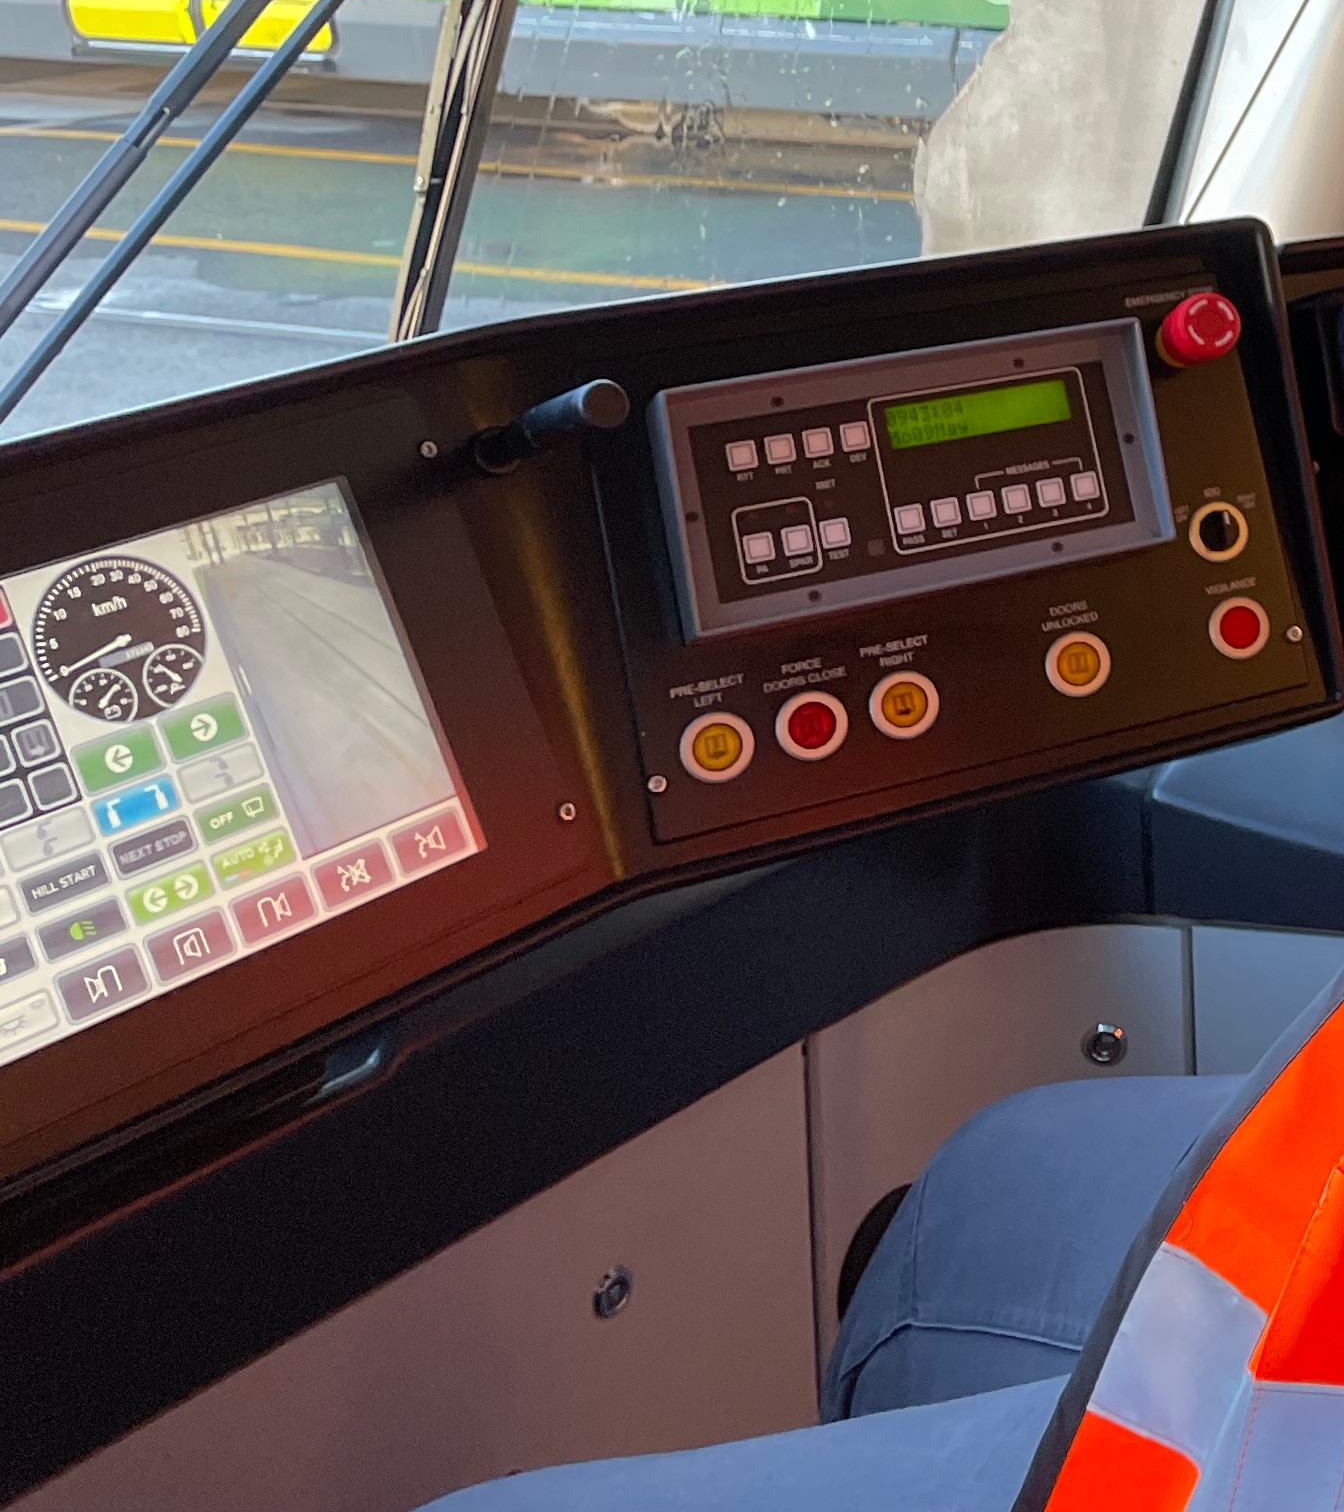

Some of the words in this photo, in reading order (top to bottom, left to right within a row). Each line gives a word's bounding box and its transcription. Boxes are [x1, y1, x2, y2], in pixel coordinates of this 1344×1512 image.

[91, 595, 129, 618] km/h
[1048, 600, 1089, 617] DOORS
[1041, 611, 1100, 632] UNLOCKED
[859, 634, 930, 658] PRE-SELECT
[780, 657, 822, 675] FORCE
[878, 652, 915, 668] RIGHT
[669, 673, 745, 699] PRE-SELECT
[763, 677, 807, 694] DOORS
[808, 666, 848, 685] CLOSE
[693, 692, 723, 708] LEFT
[208, 811, 234, 830] OFF
[119, 843, 153, 867] NEXT
[155, 830, 188, 854] STOP
[221, 848, 256, 870] AUTO
[31, 881, 59, 901] HILL
[60, 864, 97, 889] START
